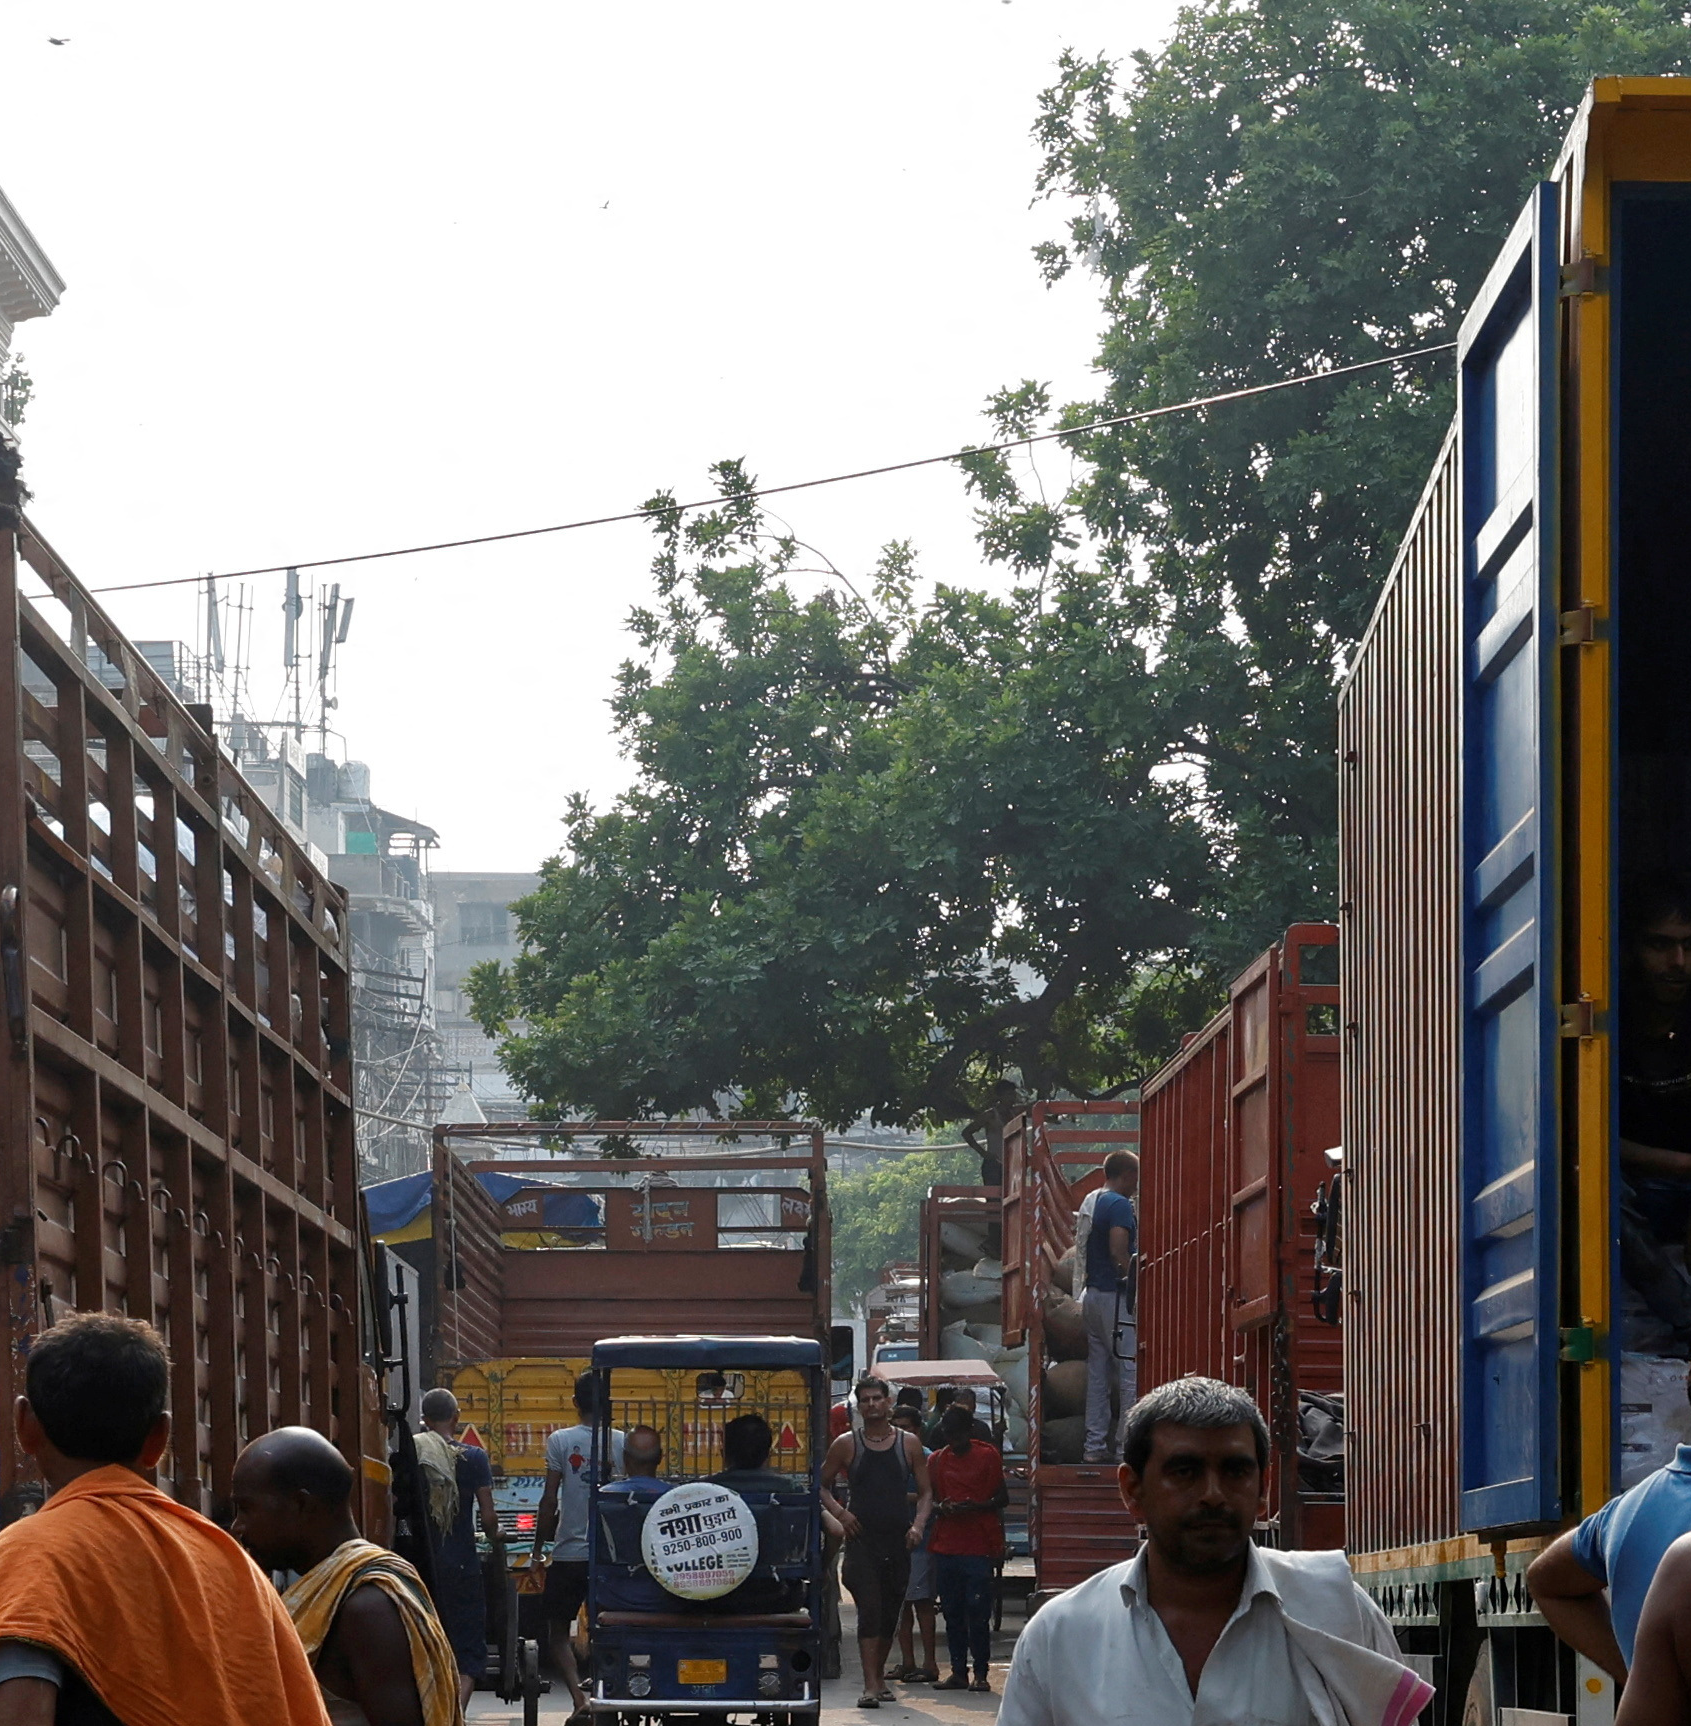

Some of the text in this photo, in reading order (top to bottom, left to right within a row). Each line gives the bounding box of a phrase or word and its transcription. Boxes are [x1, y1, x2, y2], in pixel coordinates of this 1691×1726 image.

[505, 1198, 539, 1218] भाग्य
[658, 1494, 730, 1518] सभी प्रकार का
[657, 1512, 704, 1540] नशा
[662, 1527, 744, 1557] 9250-800-900
